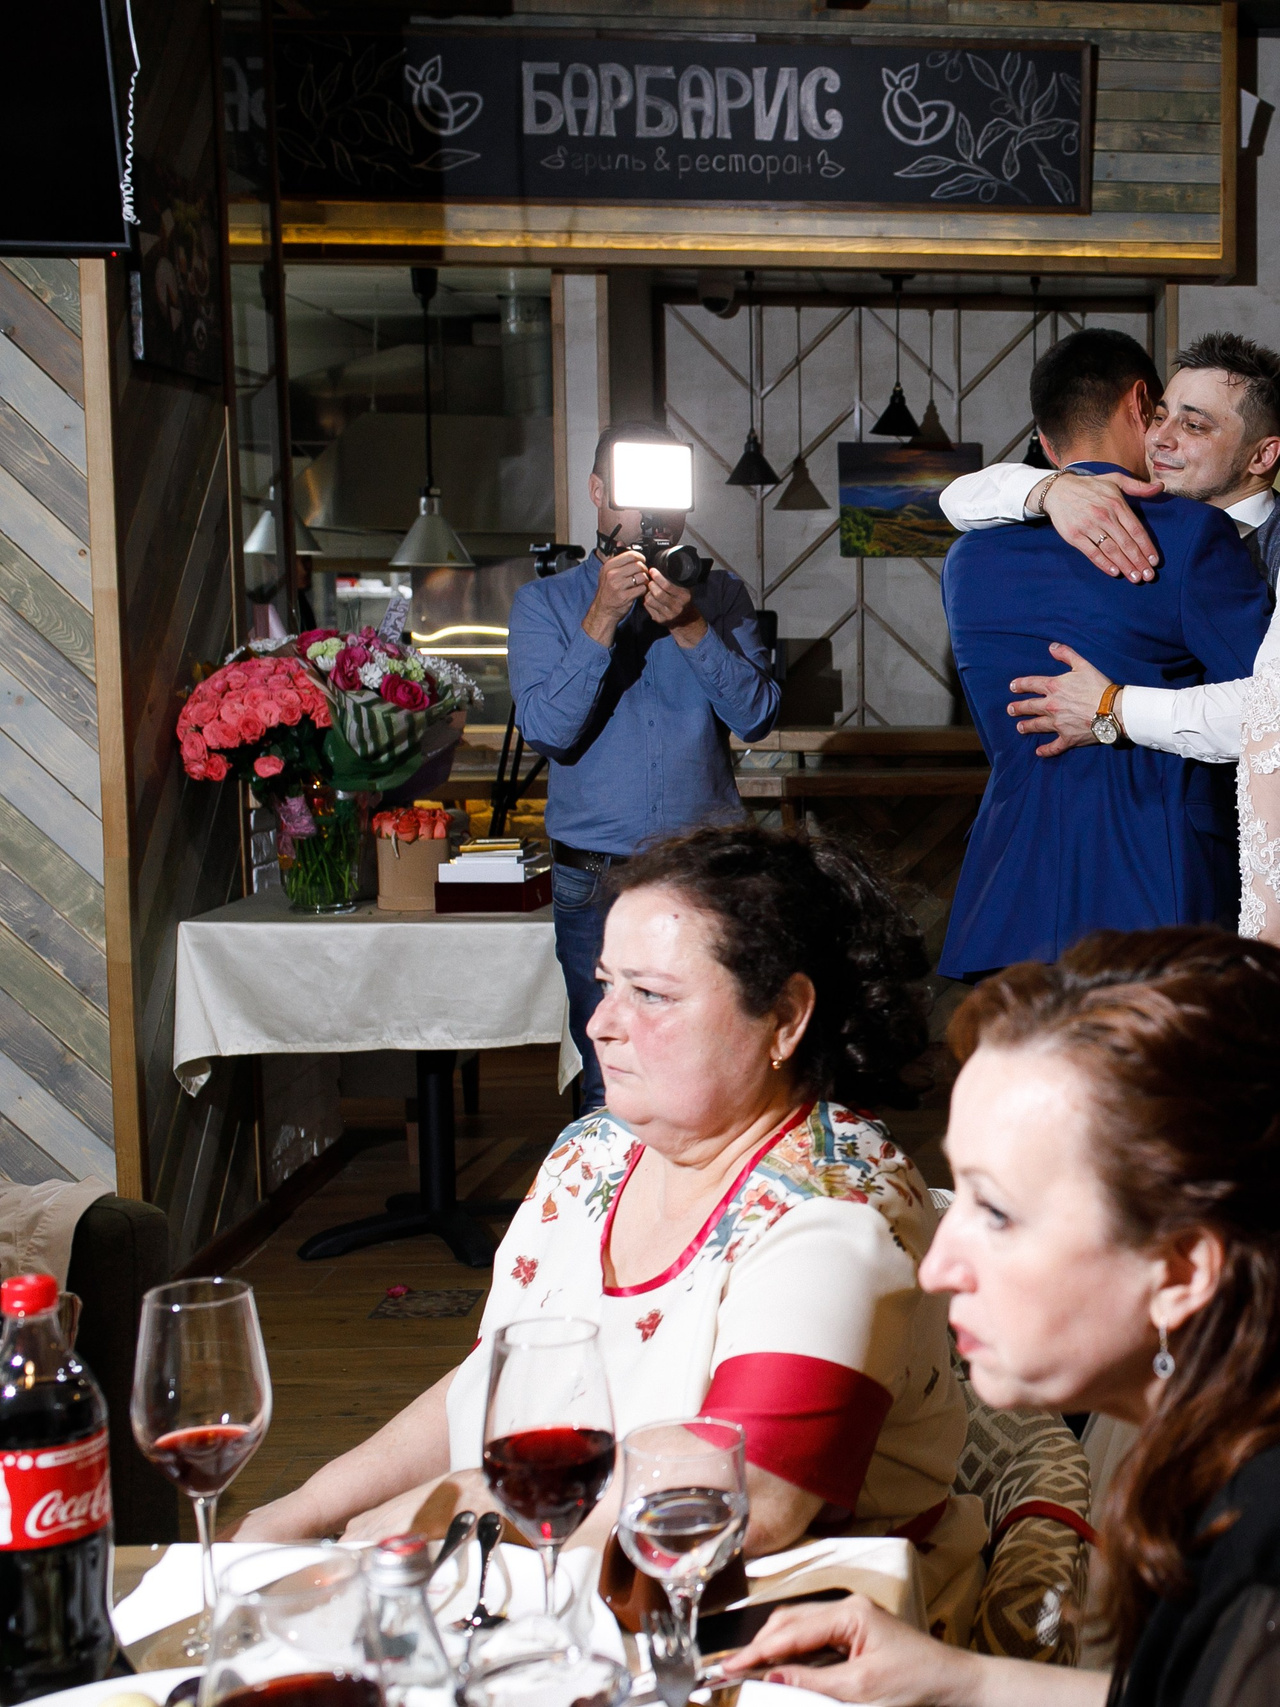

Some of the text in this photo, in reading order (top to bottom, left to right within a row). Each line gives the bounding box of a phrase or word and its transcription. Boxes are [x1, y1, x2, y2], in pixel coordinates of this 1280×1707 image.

[521, 60, 844, 142] БАРБАРИС
[571, 146, 812, 184] гриль & ресторан
